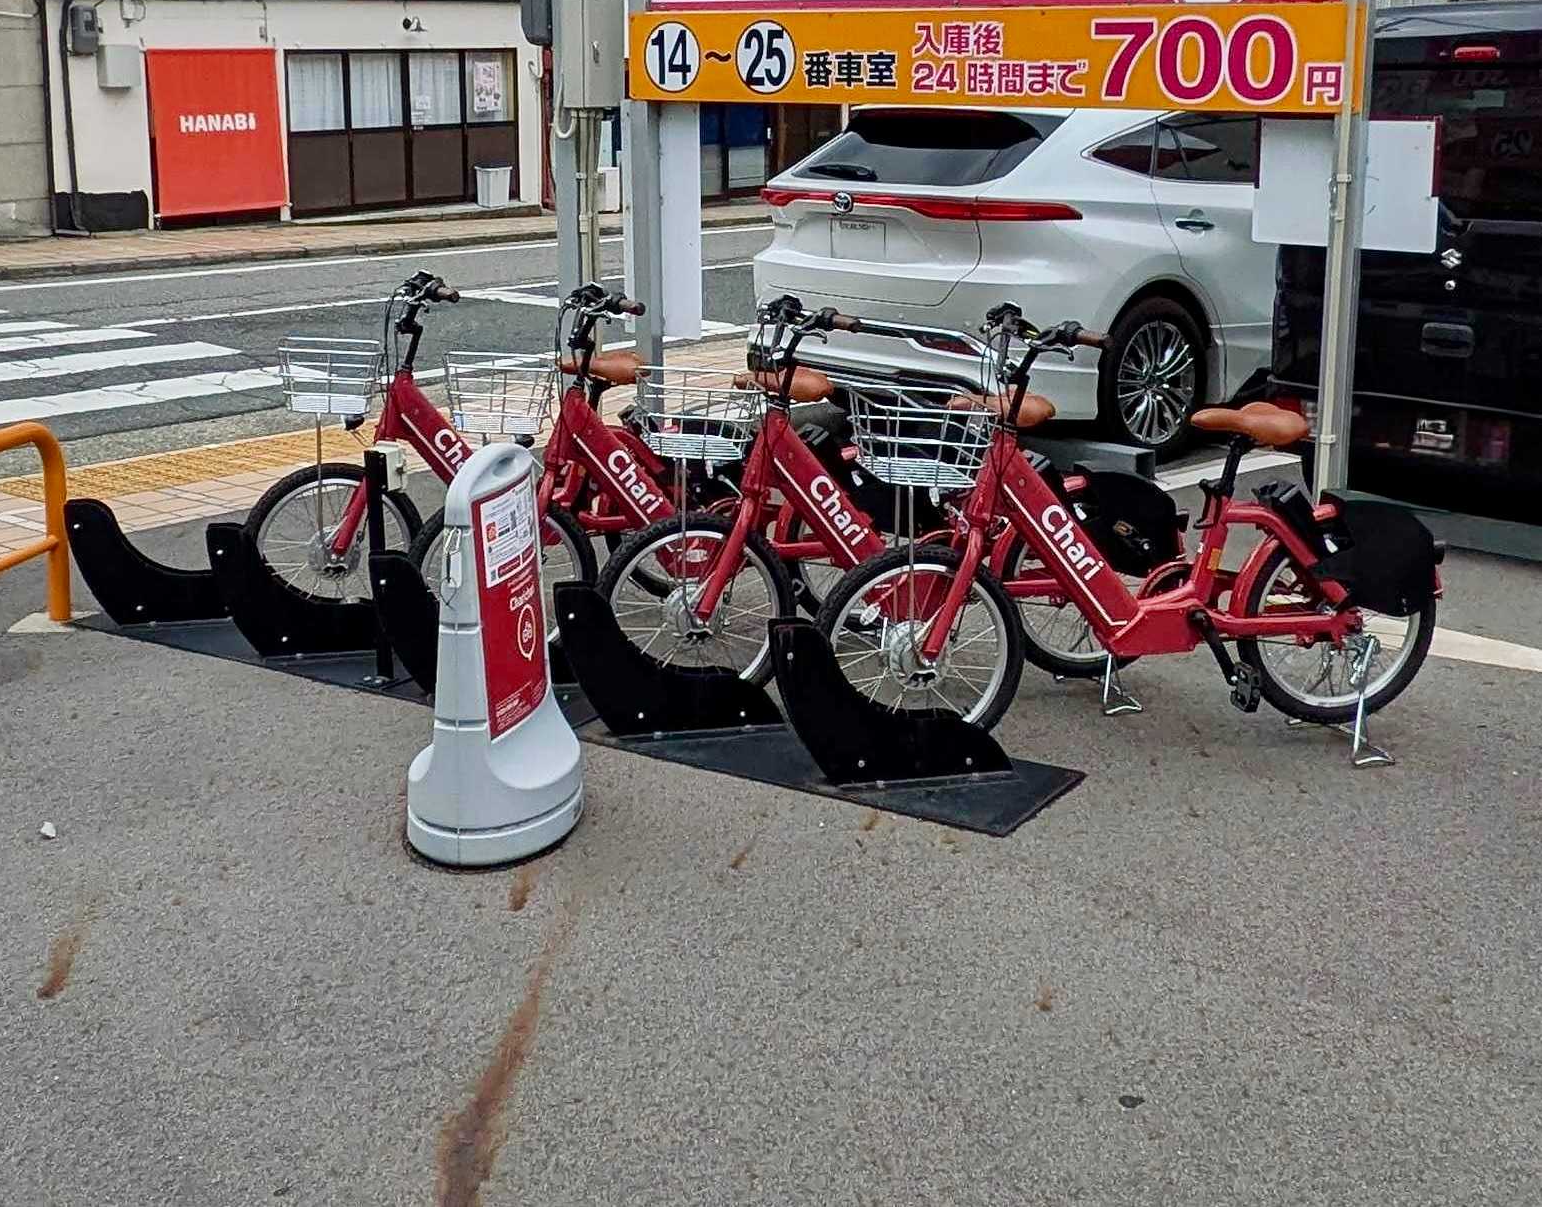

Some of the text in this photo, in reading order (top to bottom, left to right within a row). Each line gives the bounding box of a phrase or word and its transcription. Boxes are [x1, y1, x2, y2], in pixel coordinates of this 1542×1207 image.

[650, 29, 692, 86] 14
[743, 28, 788, 88] 25
[804, 51, 897, 89] 番車室
[913, 21, 1003, 57] 入庫後
[607, 449, 664, 514] Chari
[809, 474, 870, 547] Chari
[1040, 504, 1105, 581] Chari
